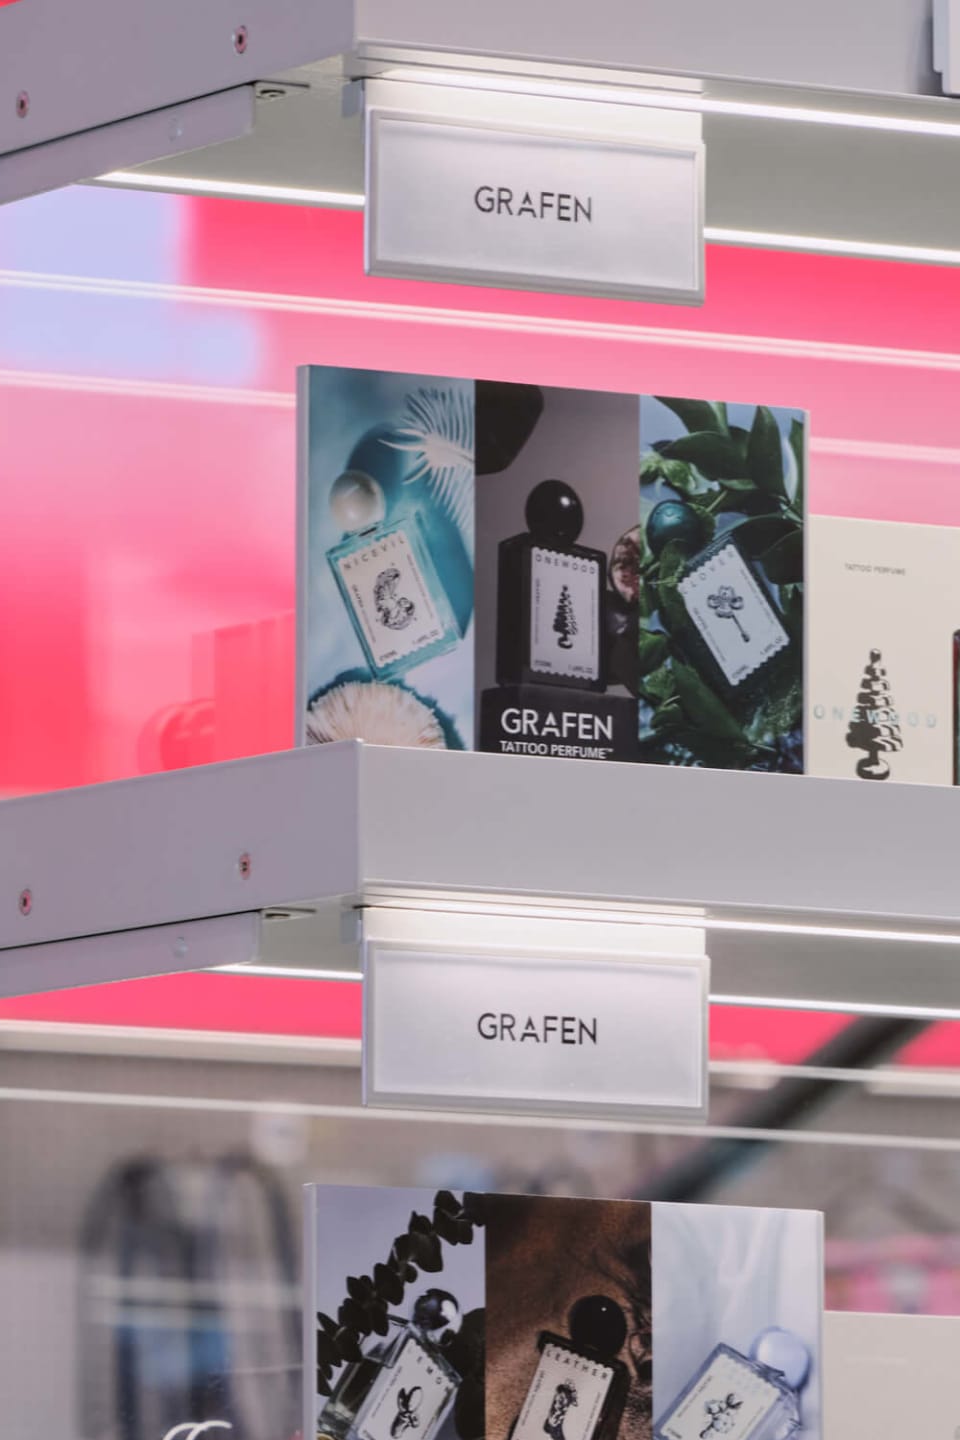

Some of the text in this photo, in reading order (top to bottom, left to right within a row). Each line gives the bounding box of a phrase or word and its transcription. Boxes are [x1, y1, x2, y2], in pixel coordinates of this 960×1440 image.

[474, 185, 592, 222] GRAFEN
[535, 554, 595, 575] ONEWOOD
[501, 708, 612, 740] GRAFEN
[500, 740, 548, 754] TATTOO
[477, 1013, 597, 1045] GRAFEN
[545, 1350, 608, 1380] LEATHER
